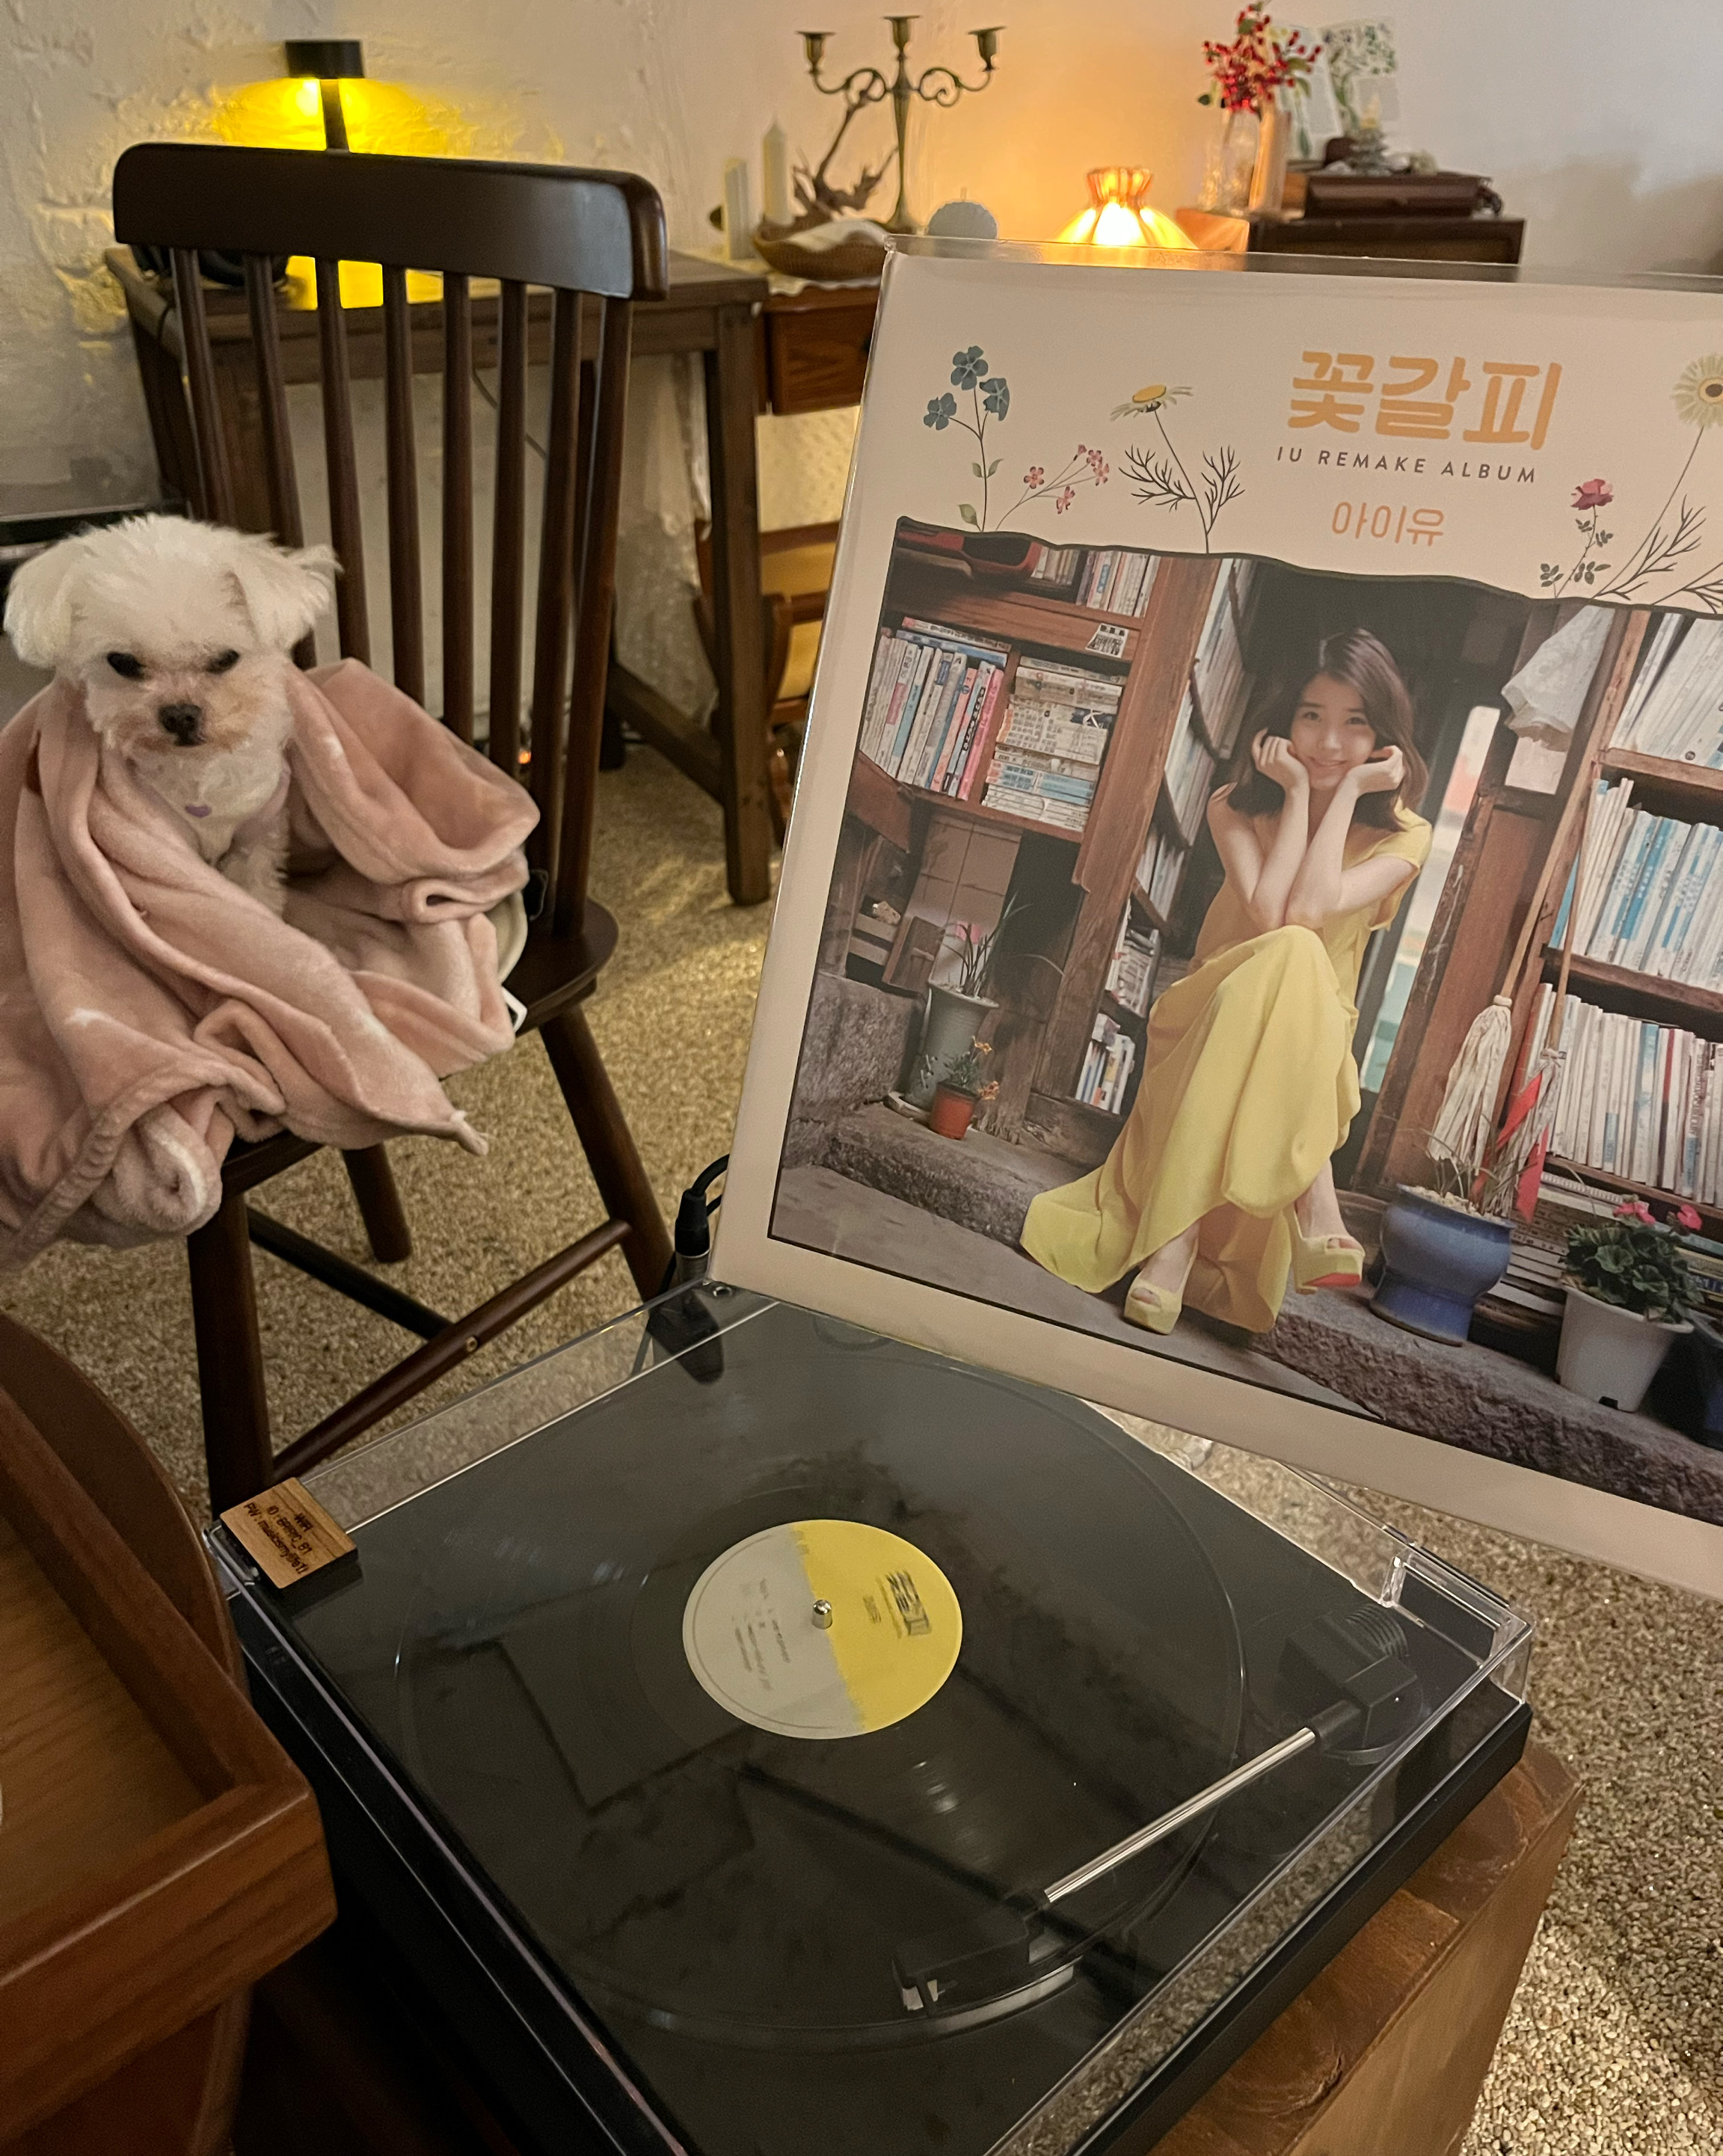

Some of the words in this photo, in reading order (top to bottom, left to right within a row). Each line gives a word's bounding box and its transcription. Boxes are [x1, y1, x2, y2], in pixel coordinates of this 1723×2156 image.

[1287, 350, 1563, 450] 꽃갈피
[1277, 446, 1303, 462] IU
[1318, 450, 1426, 473] REMAKE
[1440, 461, 1535, 483] ALBUM
[1331, 501, 1445, 547] 아이유
